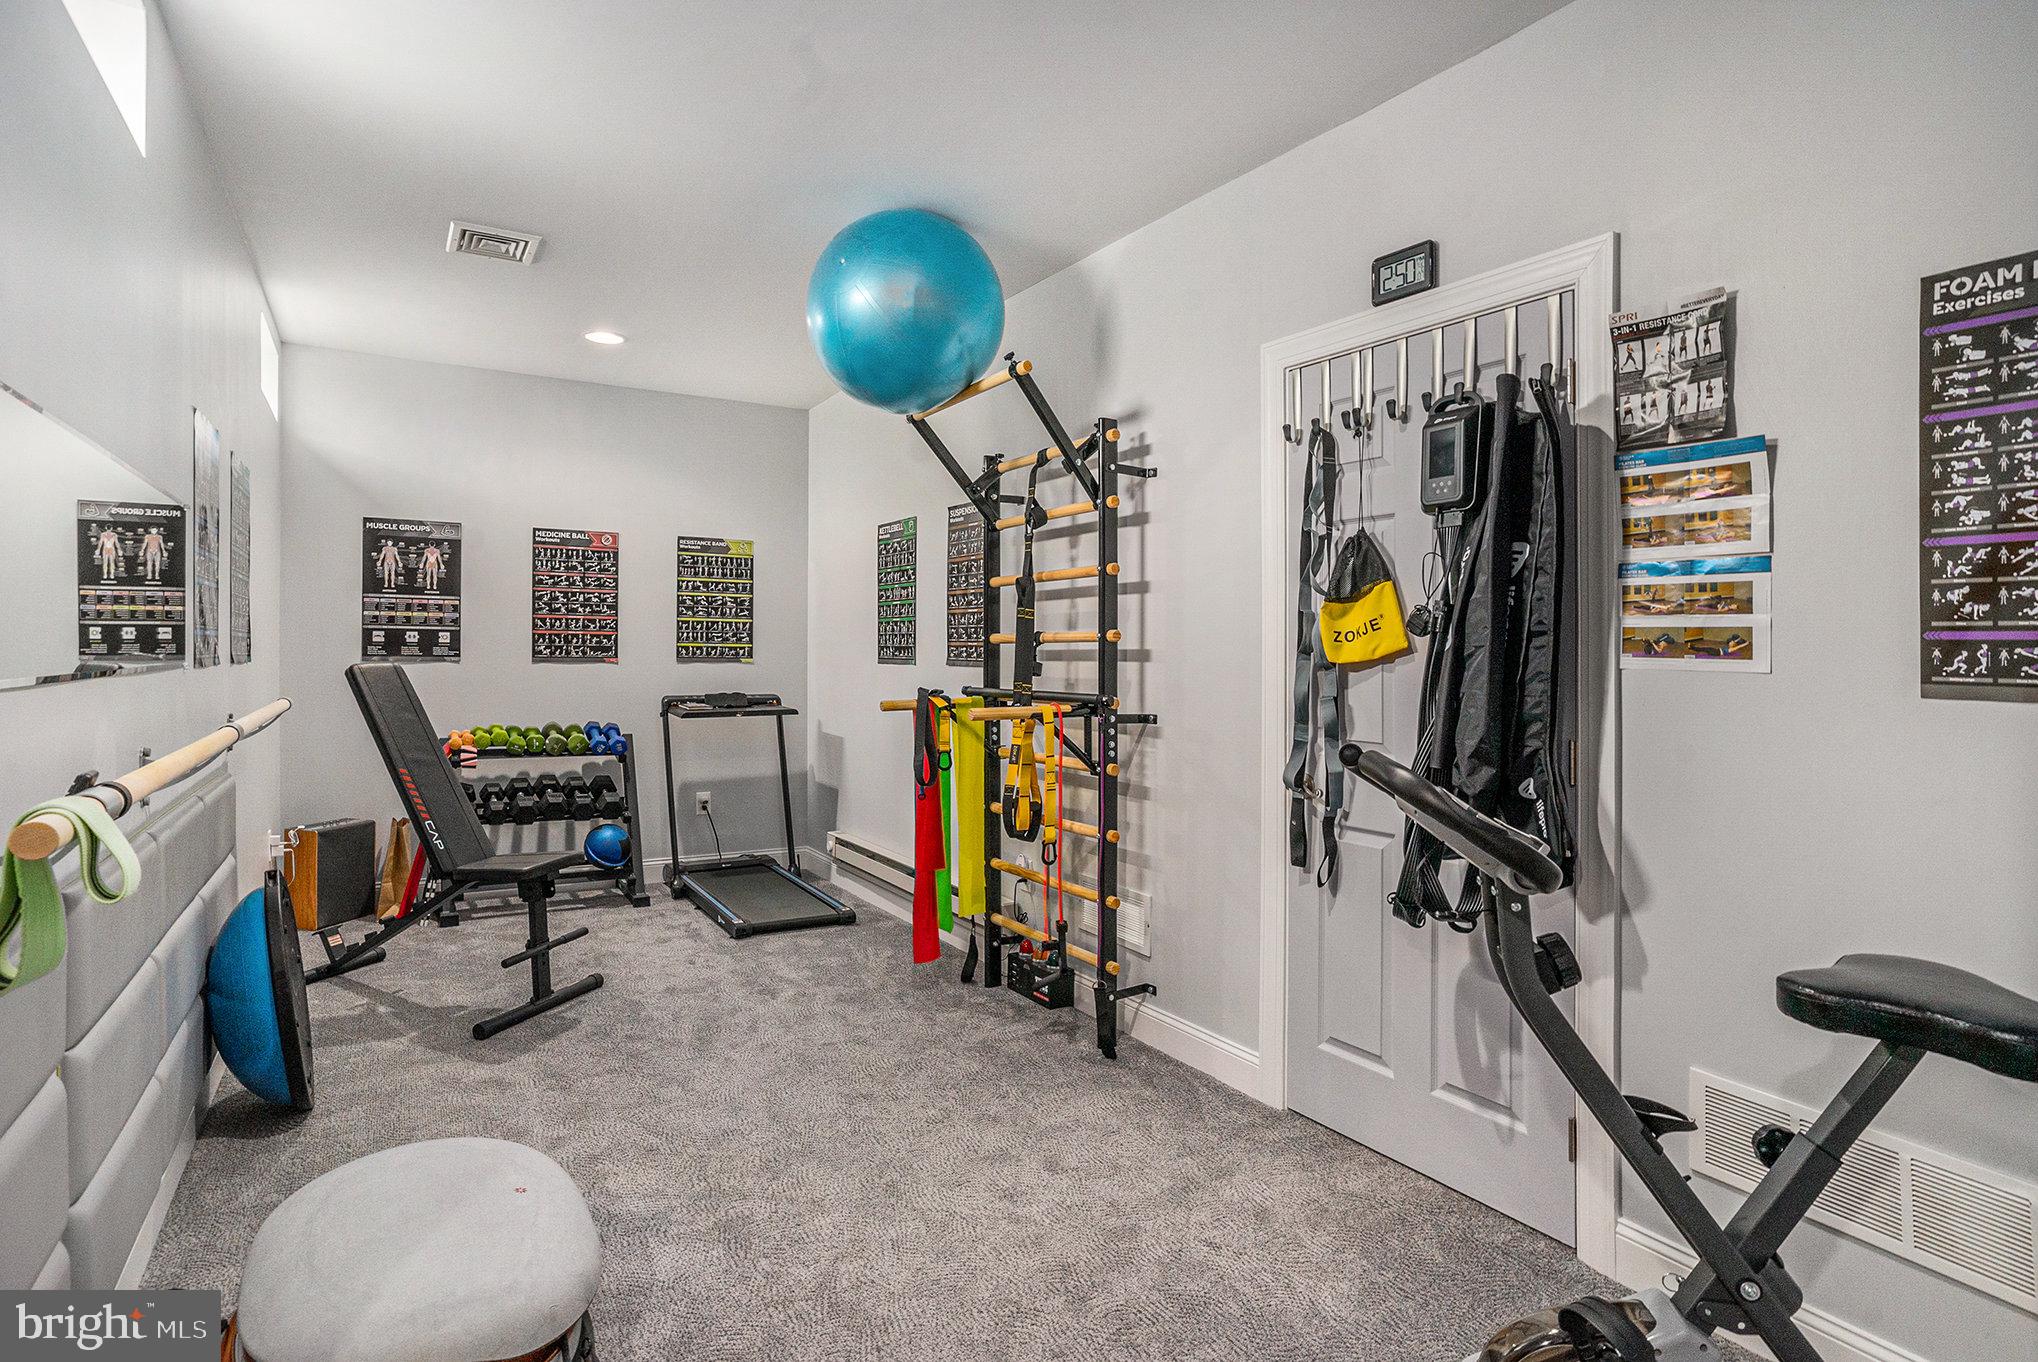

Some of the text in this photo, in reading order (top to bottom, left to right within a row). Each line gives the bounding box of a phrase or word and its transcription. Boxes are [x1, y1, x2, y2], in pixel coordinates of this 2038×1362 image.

[1934, 263, 2023, 300] FOAM
[1933, 287, 2025, 316] Exercises
[1611, 312, 1638, 325] SPRI
[1613, 324, 1637, 336] 3-IN-1
[1639, 313, 1686, 331] RESISTANCE
[366, 522, 431, 532] MUSCLE GROUPS
[535, 530, 590, 540] MEDICINE BALL
[880, 523, 904, 535] KETTLEBELL
[1536, 799, 1548, 839] lifepro
[425, 820, 445, 850] CAP
